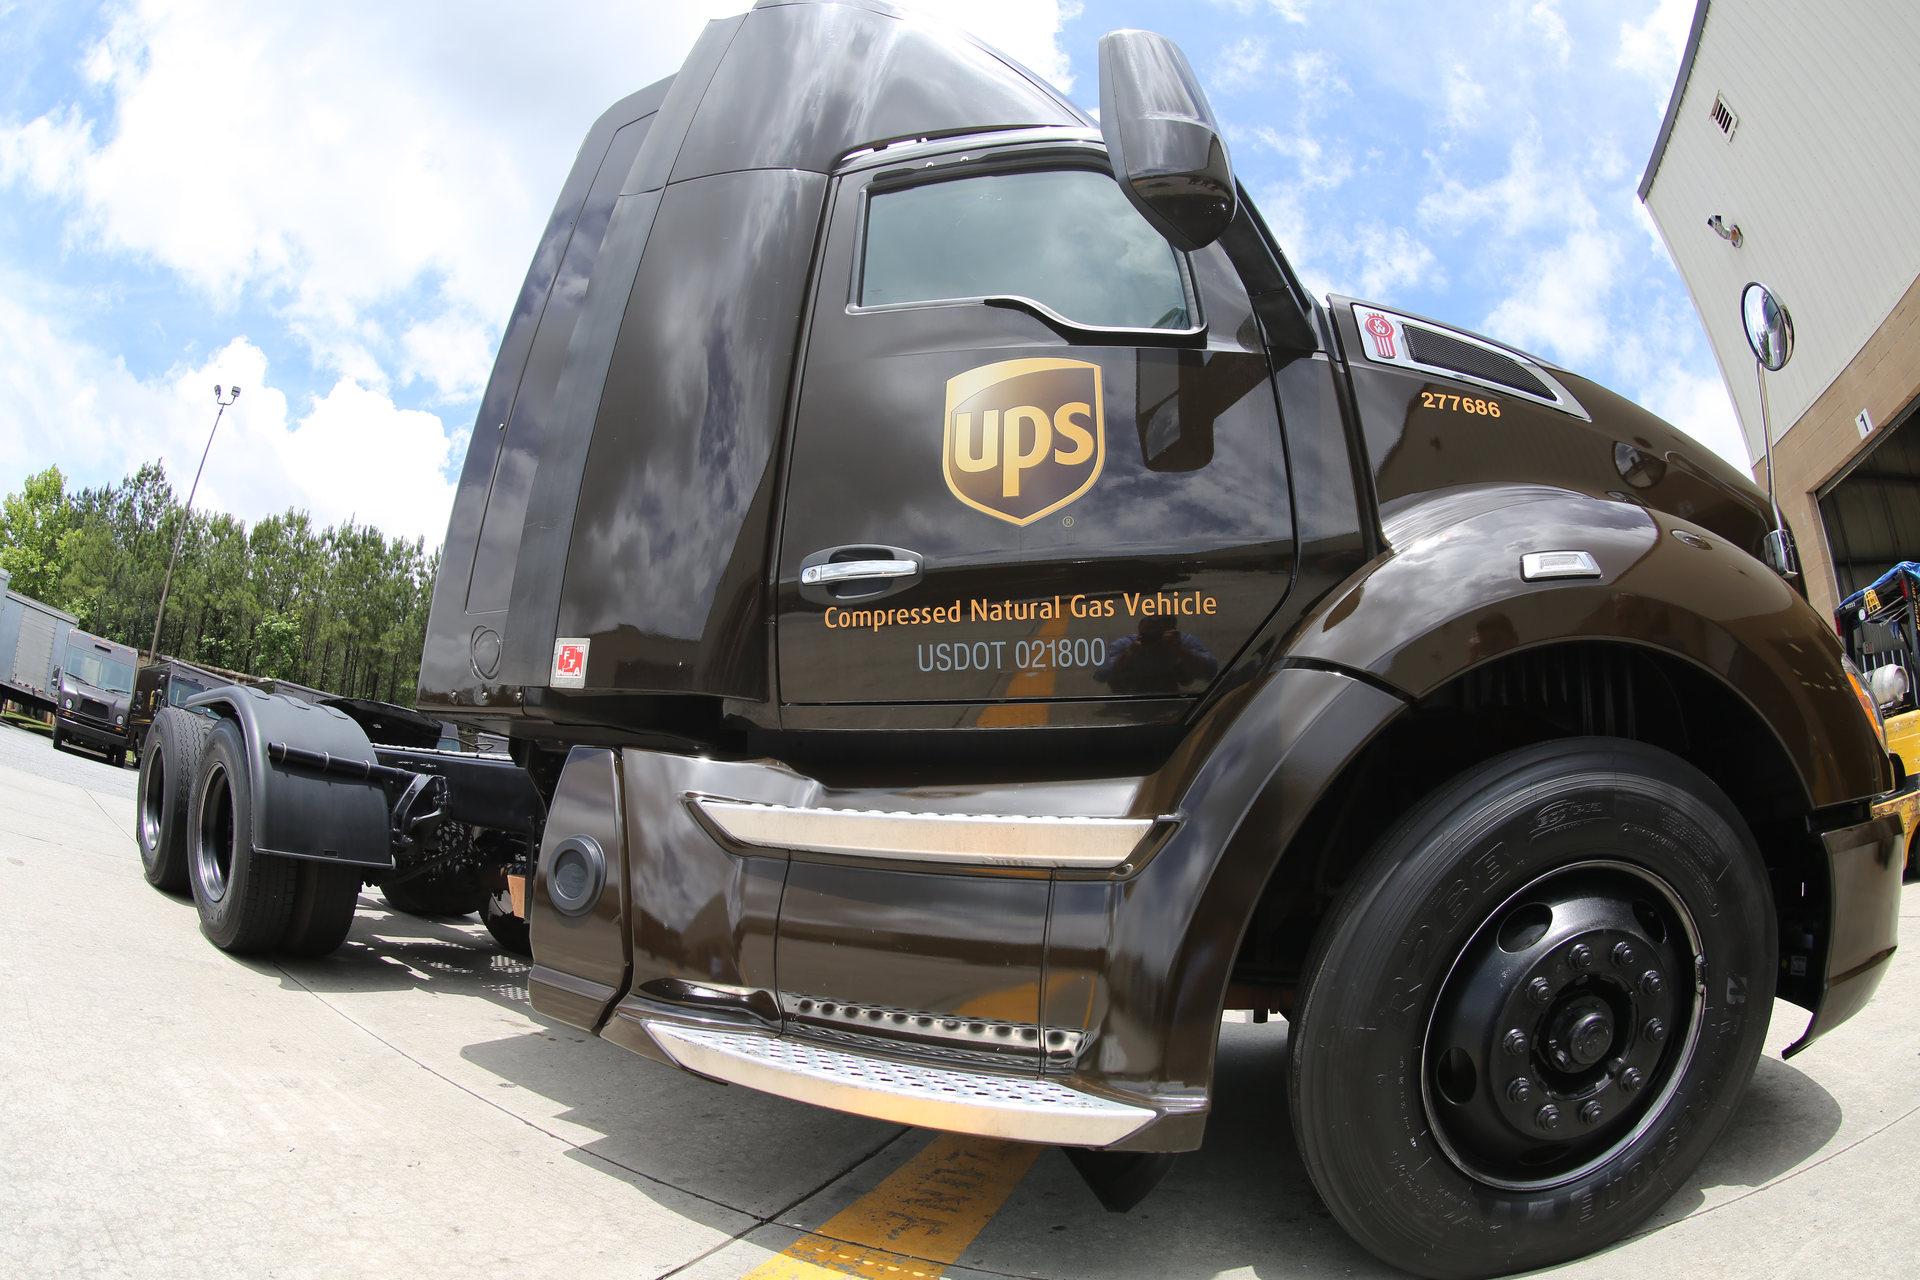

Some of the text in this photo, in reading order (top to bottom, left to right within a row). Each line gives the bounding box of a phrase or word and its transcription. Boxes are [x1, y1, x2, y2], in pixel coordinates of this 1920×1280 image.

[1421, 391, 1501, 418] 277686
[1860, 413, 1869, 432] 1
[954, 401, 1094, 497] ups
[824, 591, 1218, 632] Compressed Natural Gas Vehicle
[918, 638, 1106, 672] USDOT 021800
